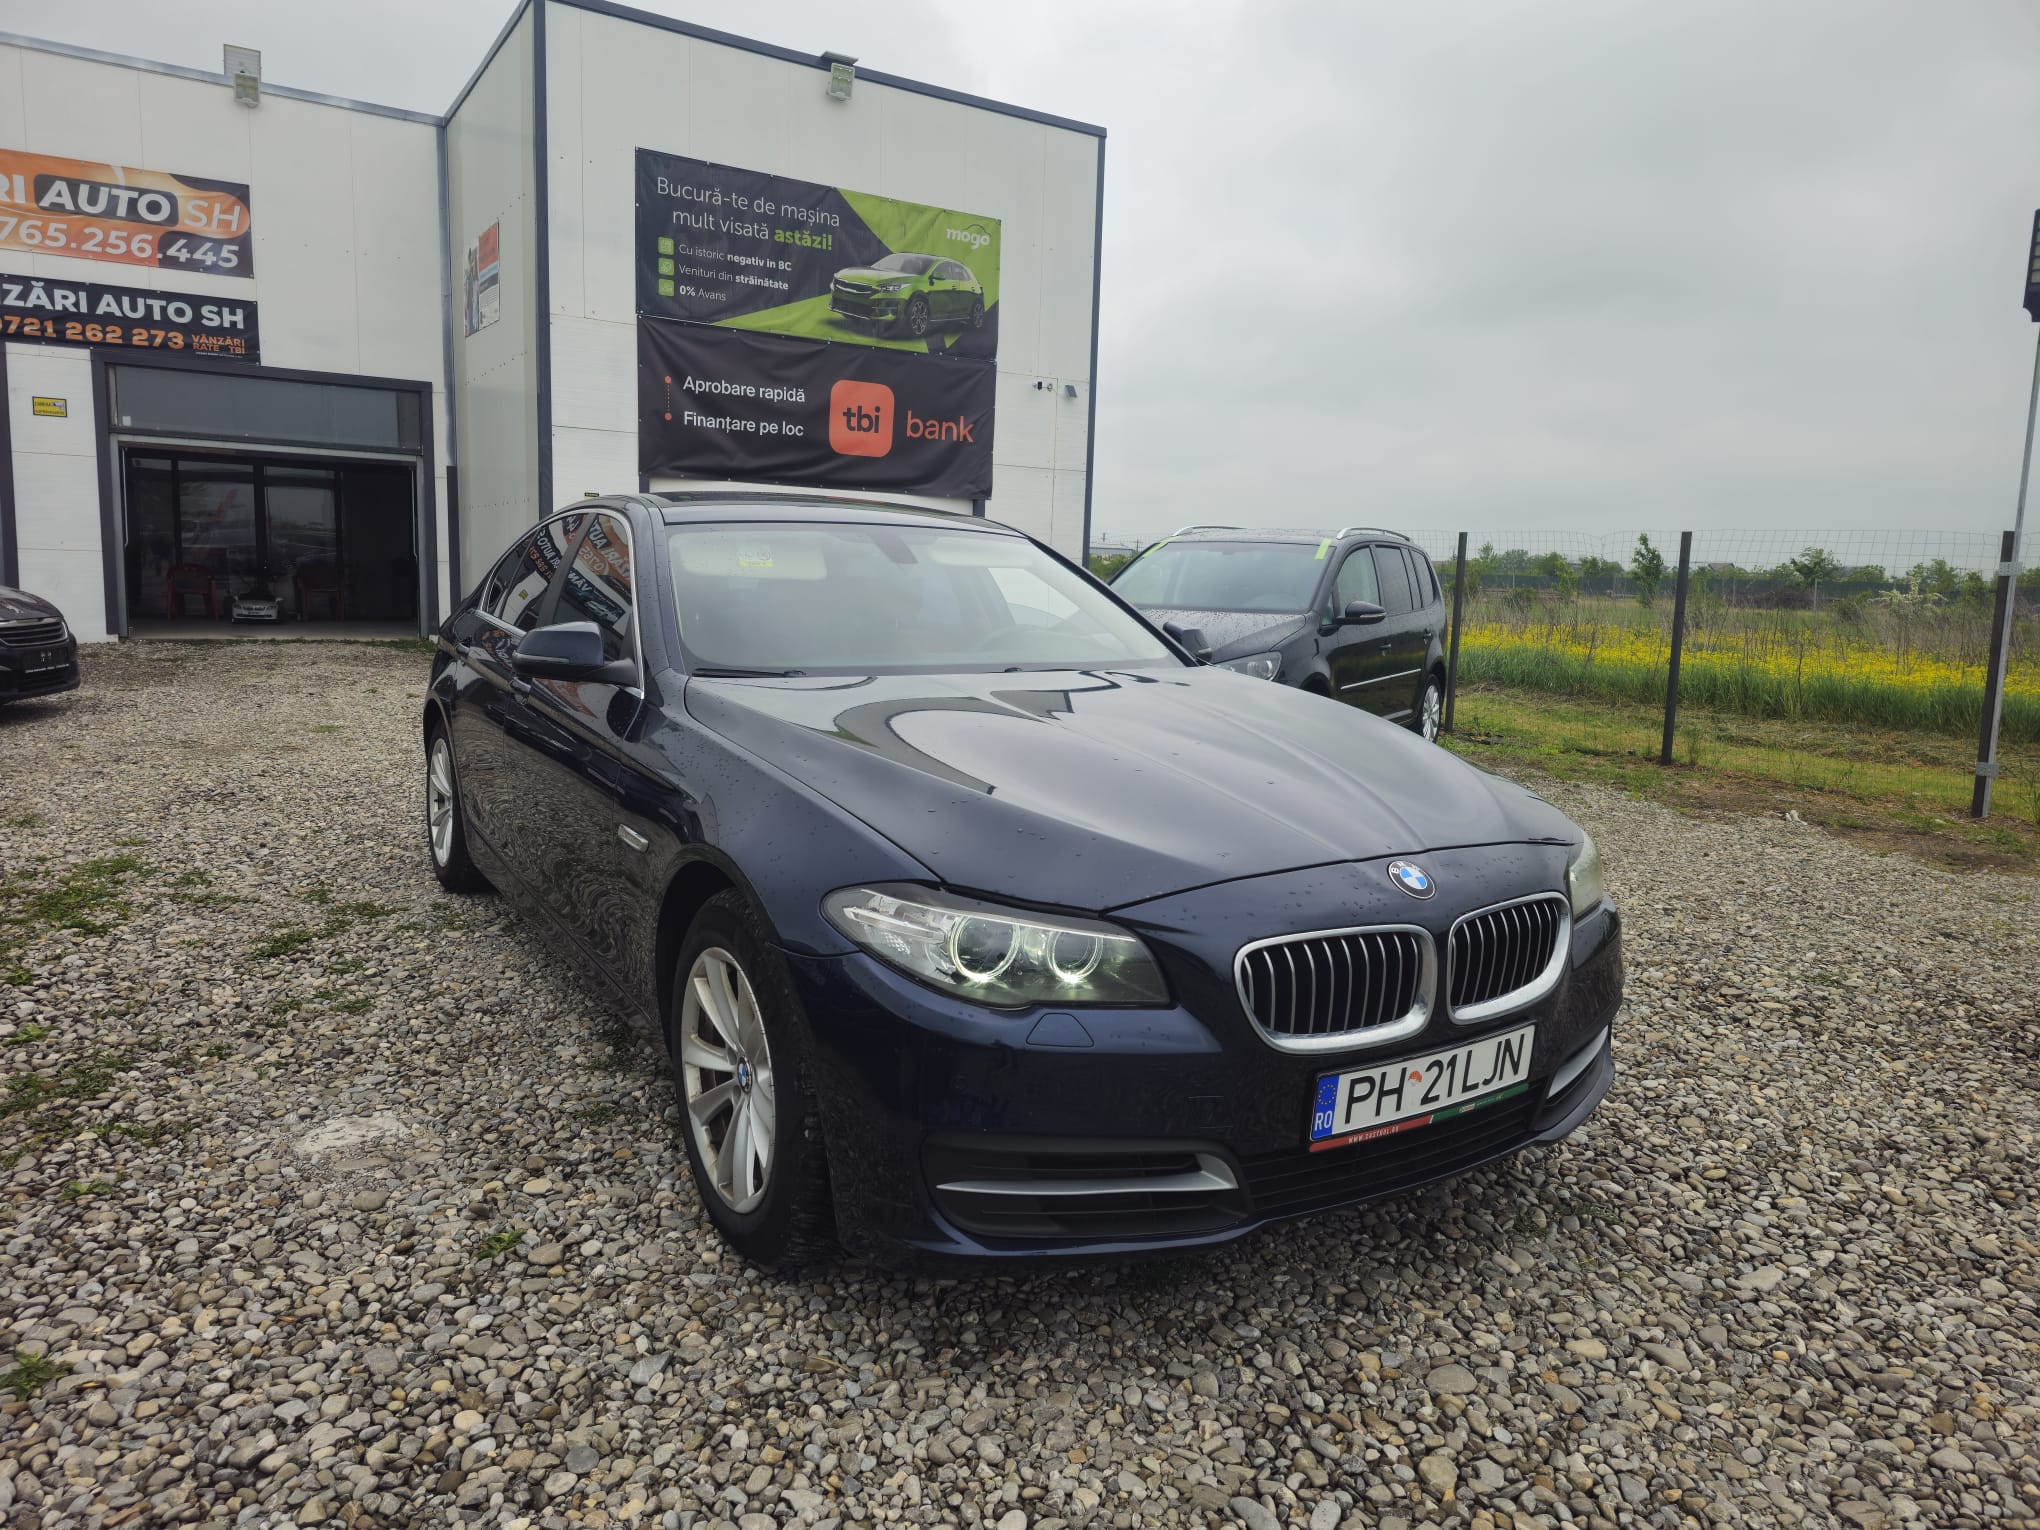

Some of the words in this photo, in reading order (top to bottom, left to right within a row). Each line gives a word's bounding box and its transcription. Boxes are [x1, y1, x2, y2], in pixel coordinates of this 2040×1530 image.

[39, 180, 171, 222] AUTO
[183, 200, 241, 232] SH
[656, 176, 749, 210] Bucură-te
[753, 197, 776, 215] de
[781, 205, 841, 229] mașina
[672, 208, 715, 232] mult
[719, 216, 770, 241] visată
[774, 228, 834, 251] astăzi!
[946, 227, 991, 250] mogo
[678, 243, 693, 256] Cu
[695, 245, 725, 262] istoric
[727, 252, 764, 269] negativ
[766, 257, 777, 270] in
[778, 260, 792, 271] BC
[678, 263, 716, 279] Venituri
[718, 268, 733, 282] din
[735, 273, 789, 290] străinătate
[2, 280, 88, 313] ZĂRI
[96, 294, 193, 324] AUTO
[201, 305, 244, 329] SH
[679, 284, 696, 298] 0%
[698, 288, 727, 302] Avans
[0, 314, 57, 337] 721
[65, 321, 123, 344] 262
[131, 327, 184, 350] 273
[193, 342, 220, 352] RATE
[683, 376, 756, 397] Aprobare
[759, 384, 806, 403] rapidă
[683, 411, 756, 434] Finanțare
[759, 421, 779, 437] pe
[782, 420, 804, 437] loc
[843, 405, 881, 434] tbi
[906, 410, 975, 443] bank
[1344, 1067, 1408, 1125] PH
[1314, 1110, 1333, 1131] RO
